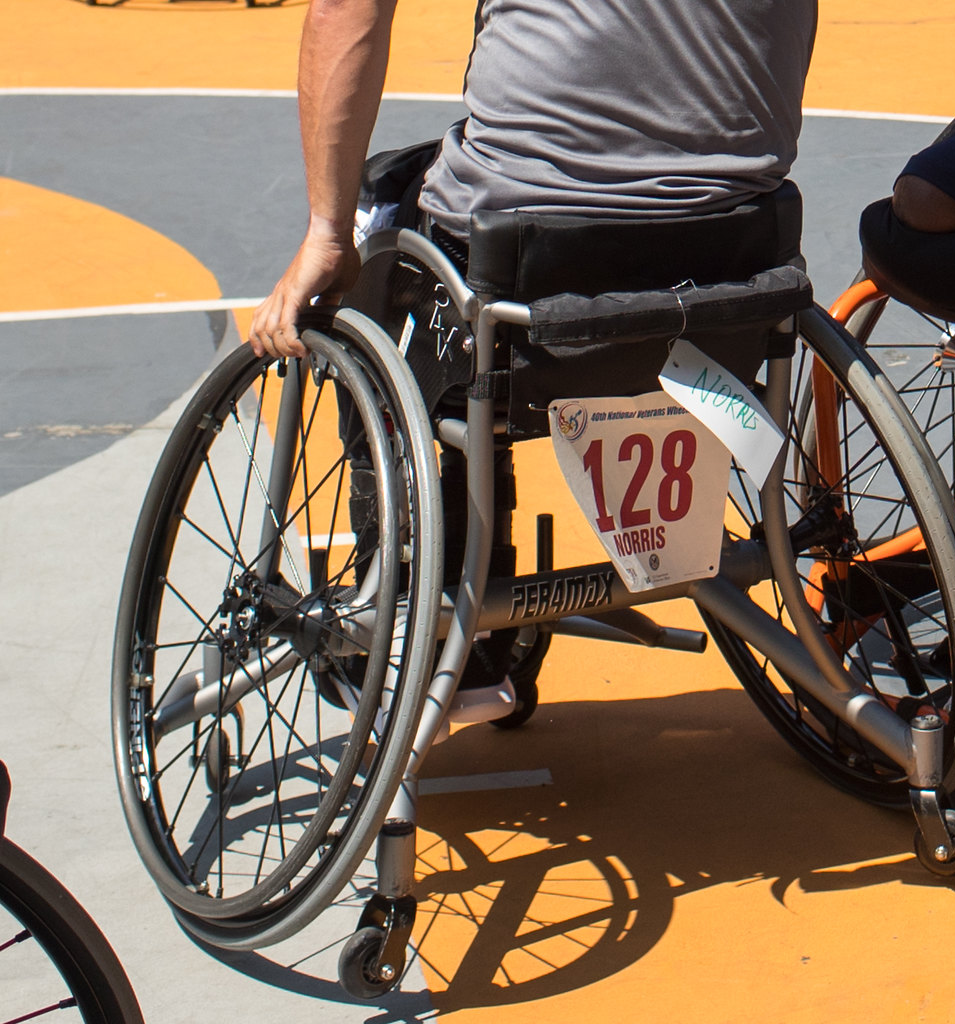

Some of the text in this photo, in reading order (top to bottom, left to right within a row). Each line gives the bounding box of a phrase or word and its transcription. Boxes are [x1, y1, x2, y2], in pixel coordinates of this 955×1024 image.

[590, 412, 607, 423] 40th
[607, 410, 637, 421] National
[637, 407, 666, 419] Veterans
[691, 366, 760, 431] NORRIS
[583, 430, 697, 533] 128
[613, 525, 666, 558] NORRIS
